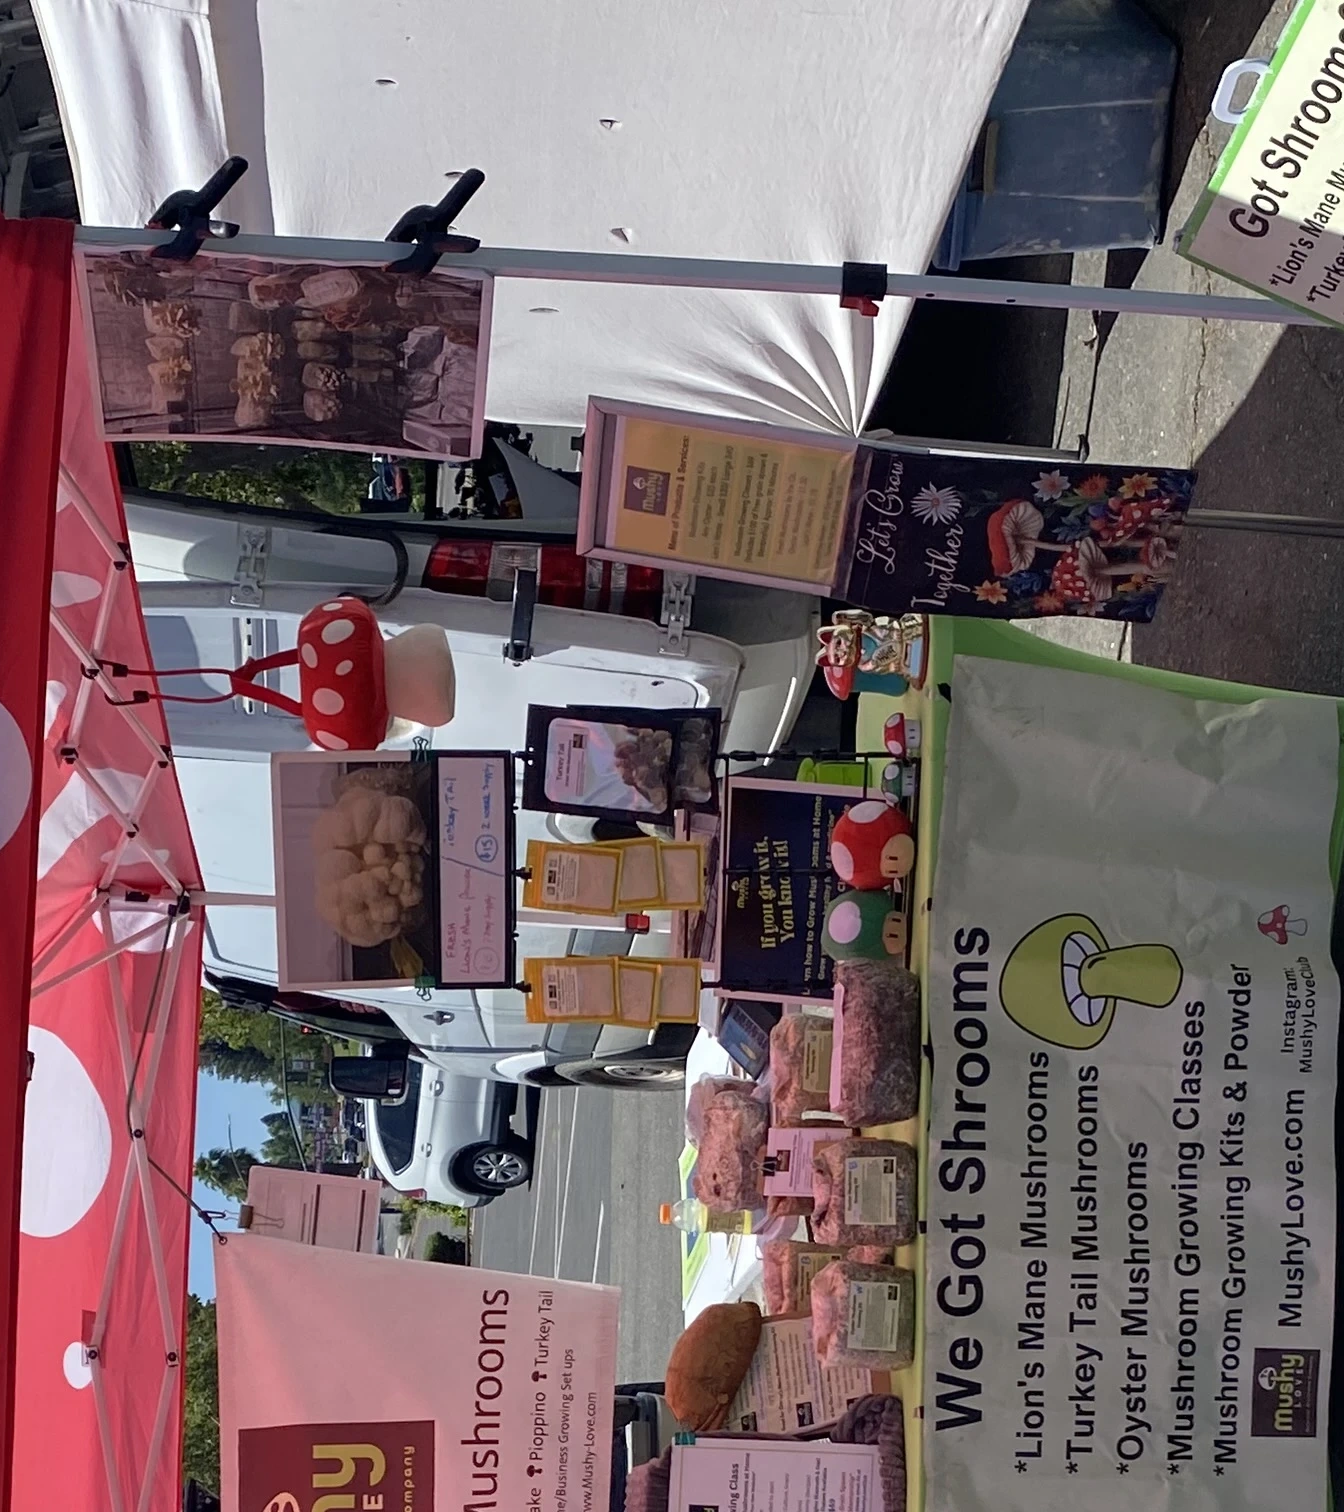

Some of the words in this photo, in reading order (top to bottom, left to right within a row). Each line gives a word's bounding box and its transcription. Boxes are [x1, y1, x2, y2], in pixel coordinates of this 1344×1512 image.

[1228, 176, 1289, 238] Got
[1298, 192, 1340, 238] Mane
[864, 460, 904, 516] Grow
[856, 519, 897, 574] Let's
[910, 522, 971, 608] Together
[812, 795, 822, 825] Home
[761, 903, 778, 934] you
[778, 908, 796, 943] You
[806, 930, 815, 942] to
[807, 900, 816, 928] Grow
[804, 944, 814, 965] how
[1223, 963, 1252, 1071] Powder
[1280, 967, 1300, 1054] Instagram:
[1297, 956, 1317, 1073] MushyLoveClub
[938, 926, 990, 1194] Shrooms
[1172, 1000, 1205, 1130] Classes
[1223, 1081, 1248, 1102] &
[1020, 1051, 1049, 1248] Mushrooms
[1070, 1065, 1099, 1261] Mushrooms
[1219, 1111, 1246, 1167] Kits
[1172, 1141, 1204, 1277] Growing
[1219, 1175, 1250, 1299] Growing
[1277, 1089, 1310, 1328] MushyLove.com
[936, 1213, 987, 1317] Got
[1120, 1142, 1149, 1337] Mushrooms
[537, 1290, 554, 1313] Tail
[1017, 1259, 1047, 1351] Mane
[1067, 1272, 1098, 1332] Tail
[534, 1317, 555, 1366] Turkey
[562, 1349, 576, 1369] ups
[559, 1372, 573, 1390] Set
[935, 1337, 983, 1431] We
[528, 1391, 550, 1461] Pioppino
[557, 1393, 574, 1443] Growing
[729, 1463, 739, 1490] Class
